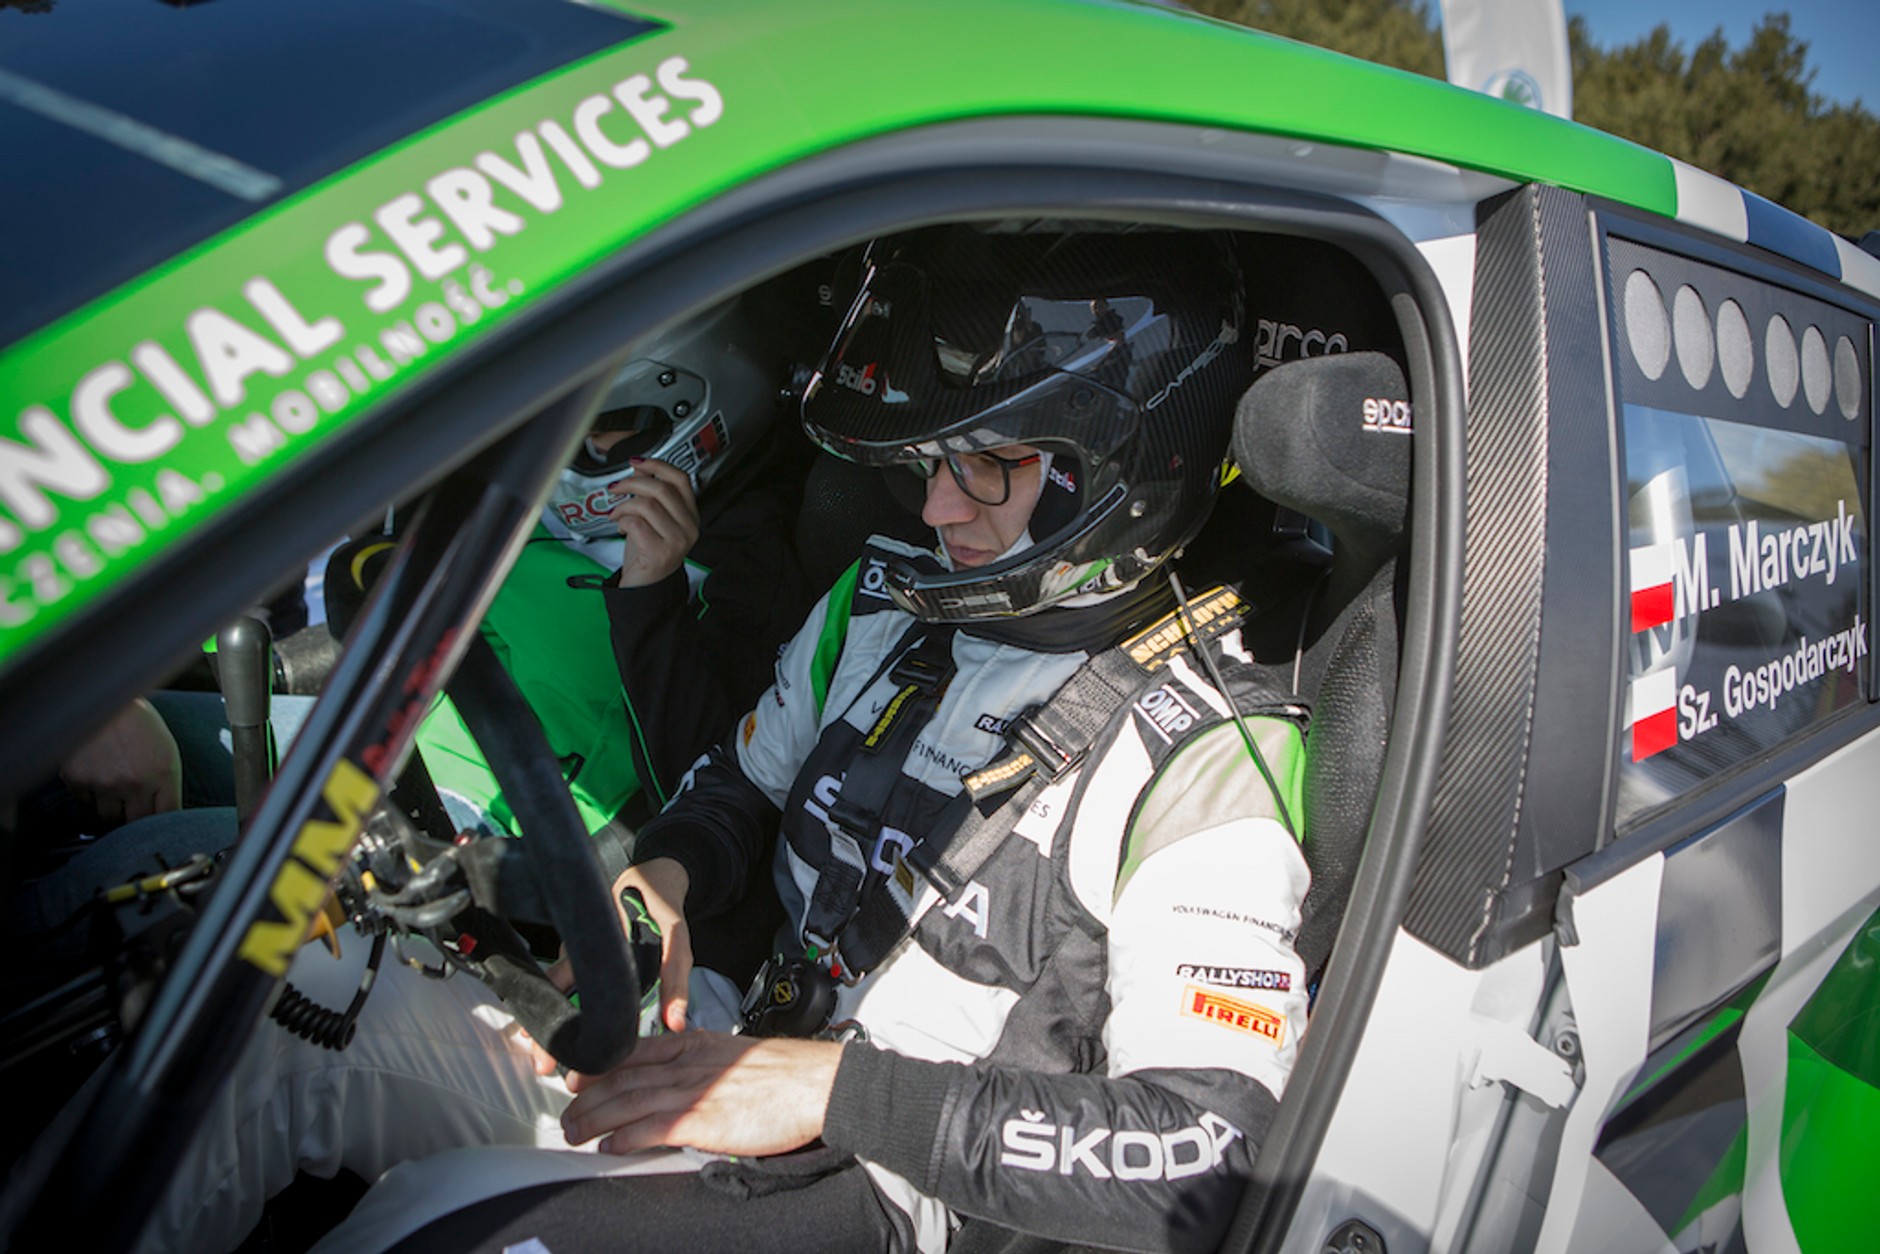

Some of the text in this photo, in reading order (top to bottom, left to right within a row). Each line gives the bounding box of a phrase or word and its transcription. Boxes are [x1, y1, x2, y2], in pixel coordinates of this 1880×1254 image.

[0, 56, 723, 553] NCIAL SERVICES
[1252, 318, 1348, 375] arco
[1362, 398, 1411, 432] spa
[559, 486, 632, 525] RC
[1674, 499, 1857, 620] M. Marczyk
[1678, 614, 1868, 741] Sz. Gospodarczyk
[1140, 690, 1193, 734] OMP
[912, 739, 978, 777] FINANC
[1192, 991, 1281, 1040] PIRELLI
[1001, 1109, 1243, 1182] ŠKODA
